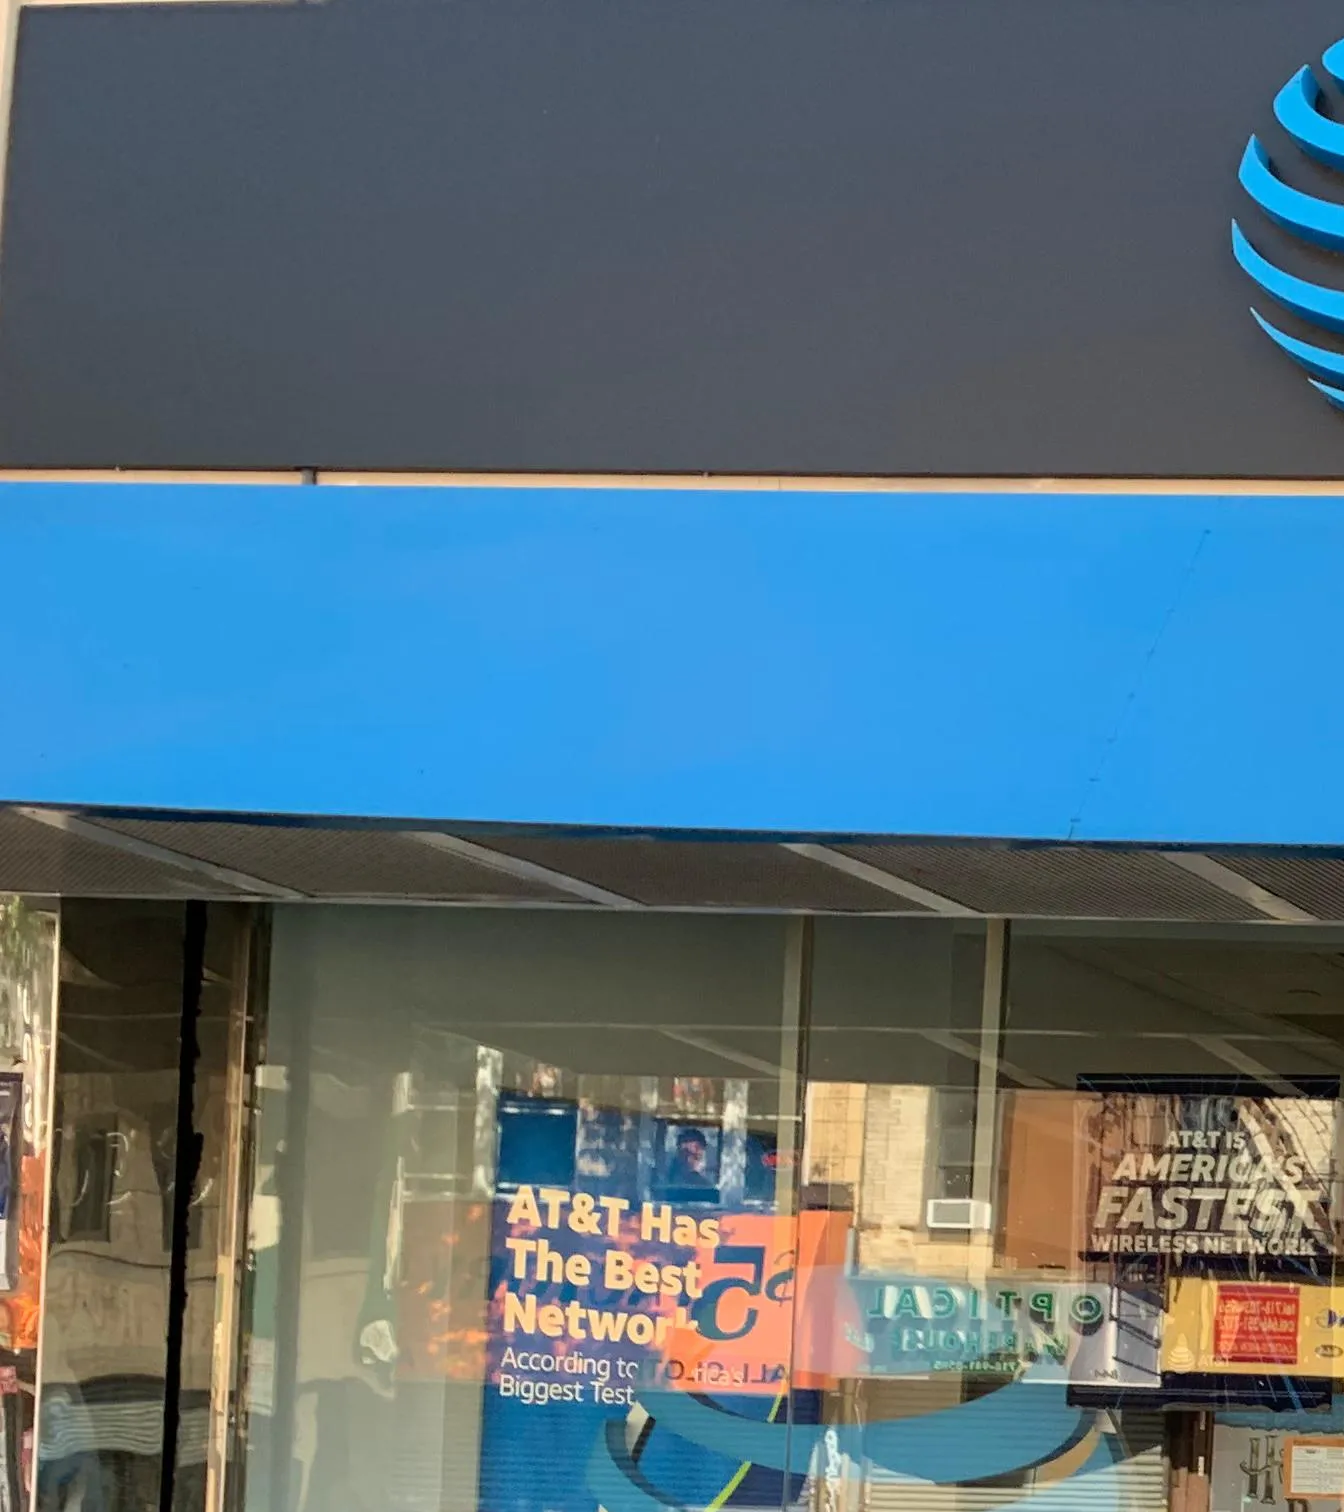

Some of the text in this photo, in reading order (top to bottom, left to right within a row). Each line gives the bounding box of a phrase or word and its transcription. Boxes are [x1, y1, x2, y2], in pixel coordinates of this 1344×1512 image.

[1166, 1131, 1248, 1150] AT&T IS
[1111, 1152, 1306, 1184] AMERICA'S
[506, 1185, 720, 1249] AT&T Has
[1094, 1186, 1322, 1231] FASTEST
[1091, 1234, 1316, 1256] WIRELESS NETWORK
[505, 1238, 703, 1299] The Best
[501, 1347, 610, 1381] According
[500, 1375, 584, 1405] Biggest
